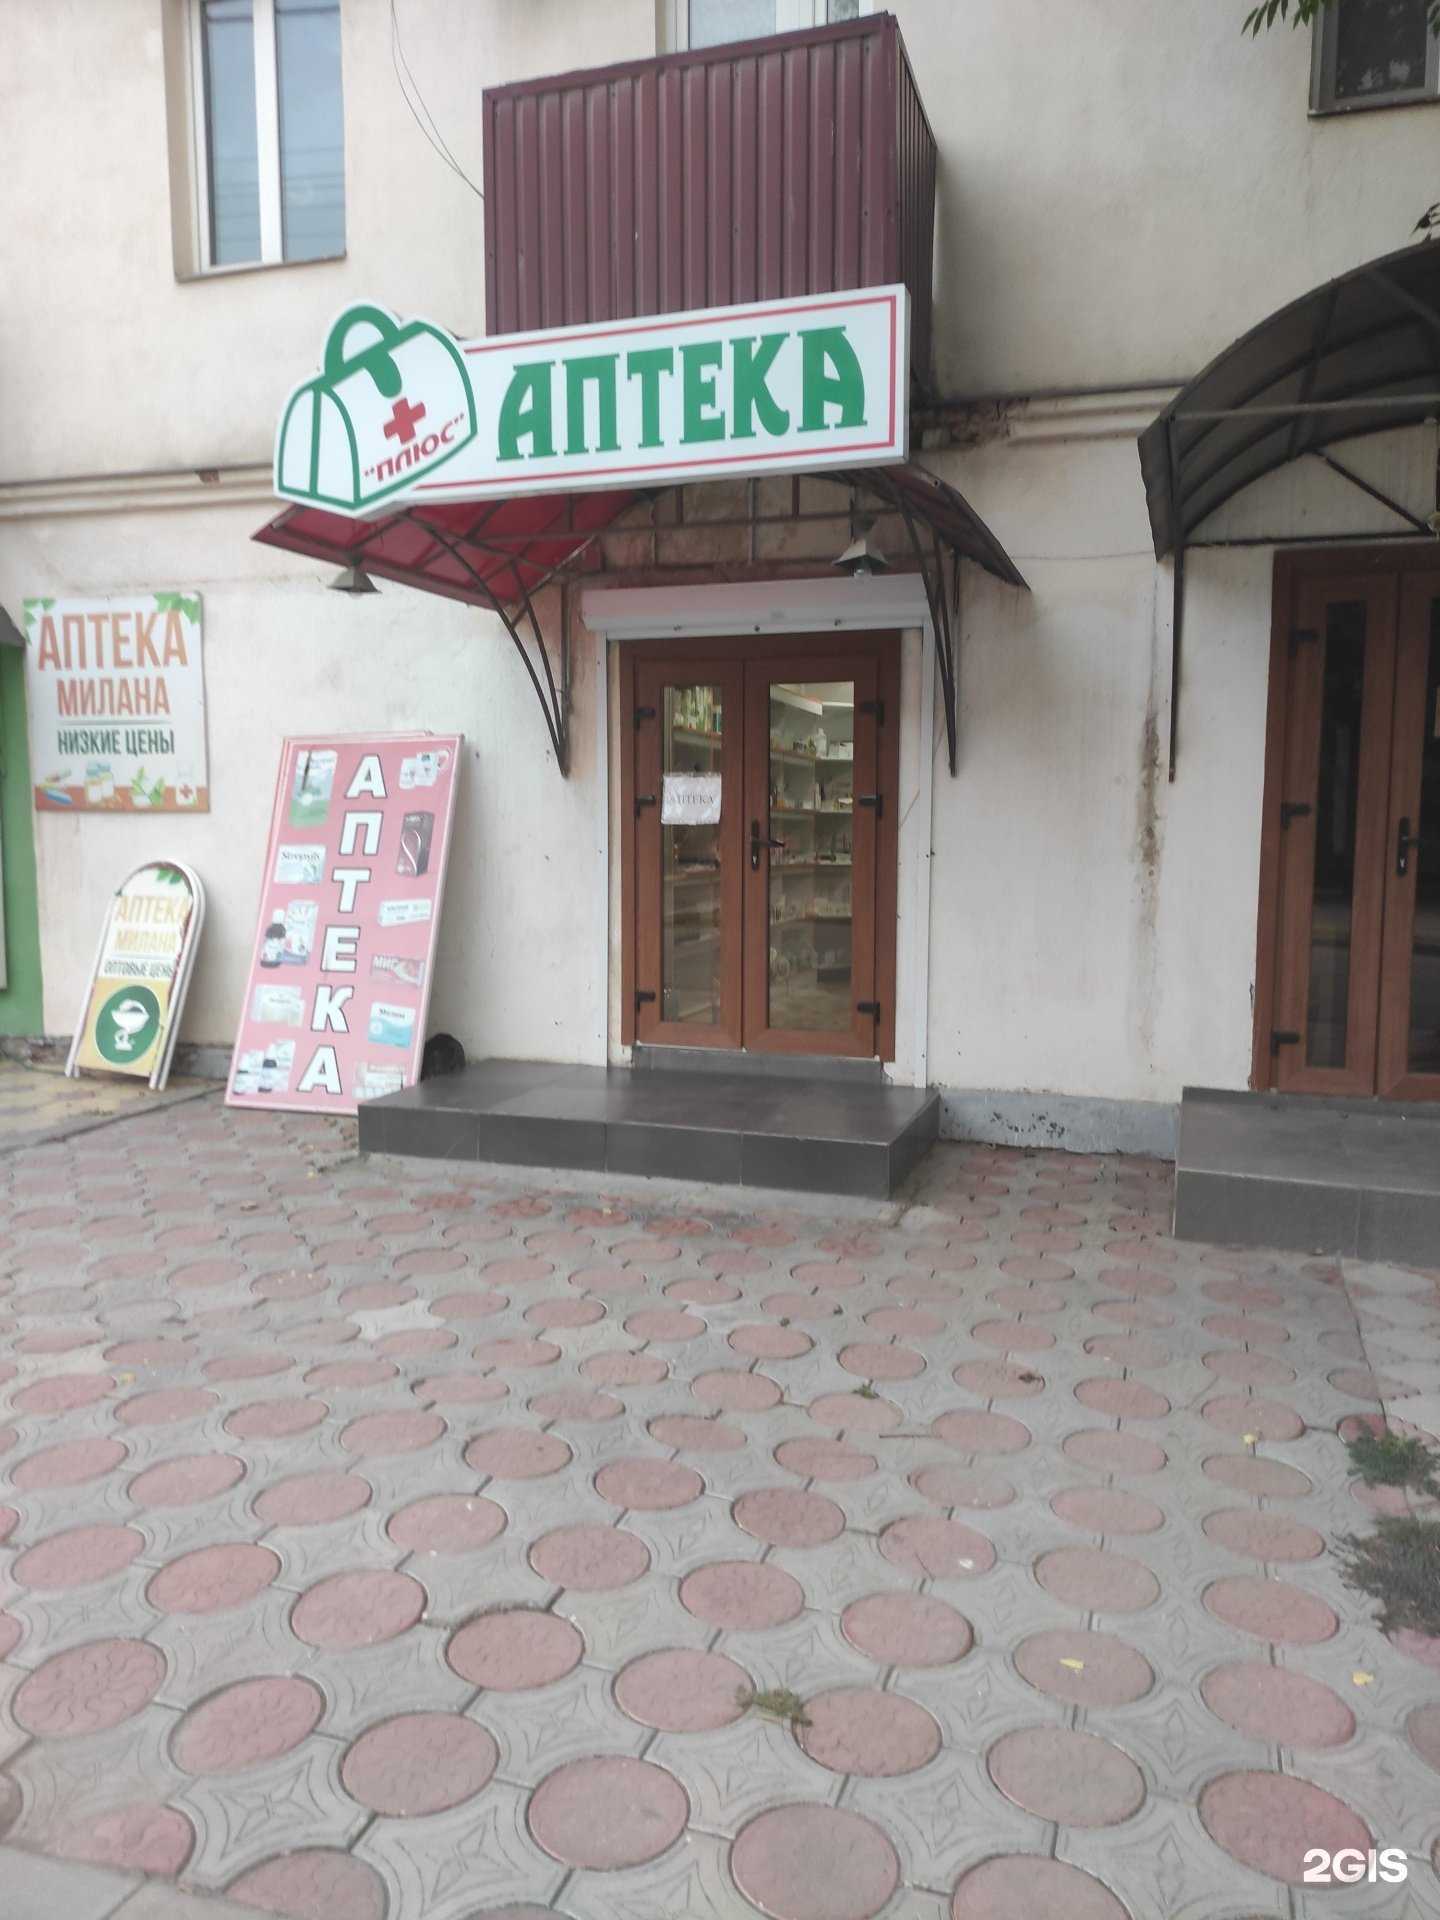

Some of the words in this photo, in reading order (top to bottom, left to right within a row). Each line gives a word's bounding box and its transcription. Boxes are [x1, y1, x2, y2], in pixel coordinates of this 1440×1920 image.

[497, 325, 868, 463] АПТЕКА
[38, 610, 188, 671] АПТЕКА
[57, 677, 170, 716] МИЛАНА
[58, 731, 122, 755] НИЗКИЕ
[126, 730, 175, 757] ЦЕНЫ
